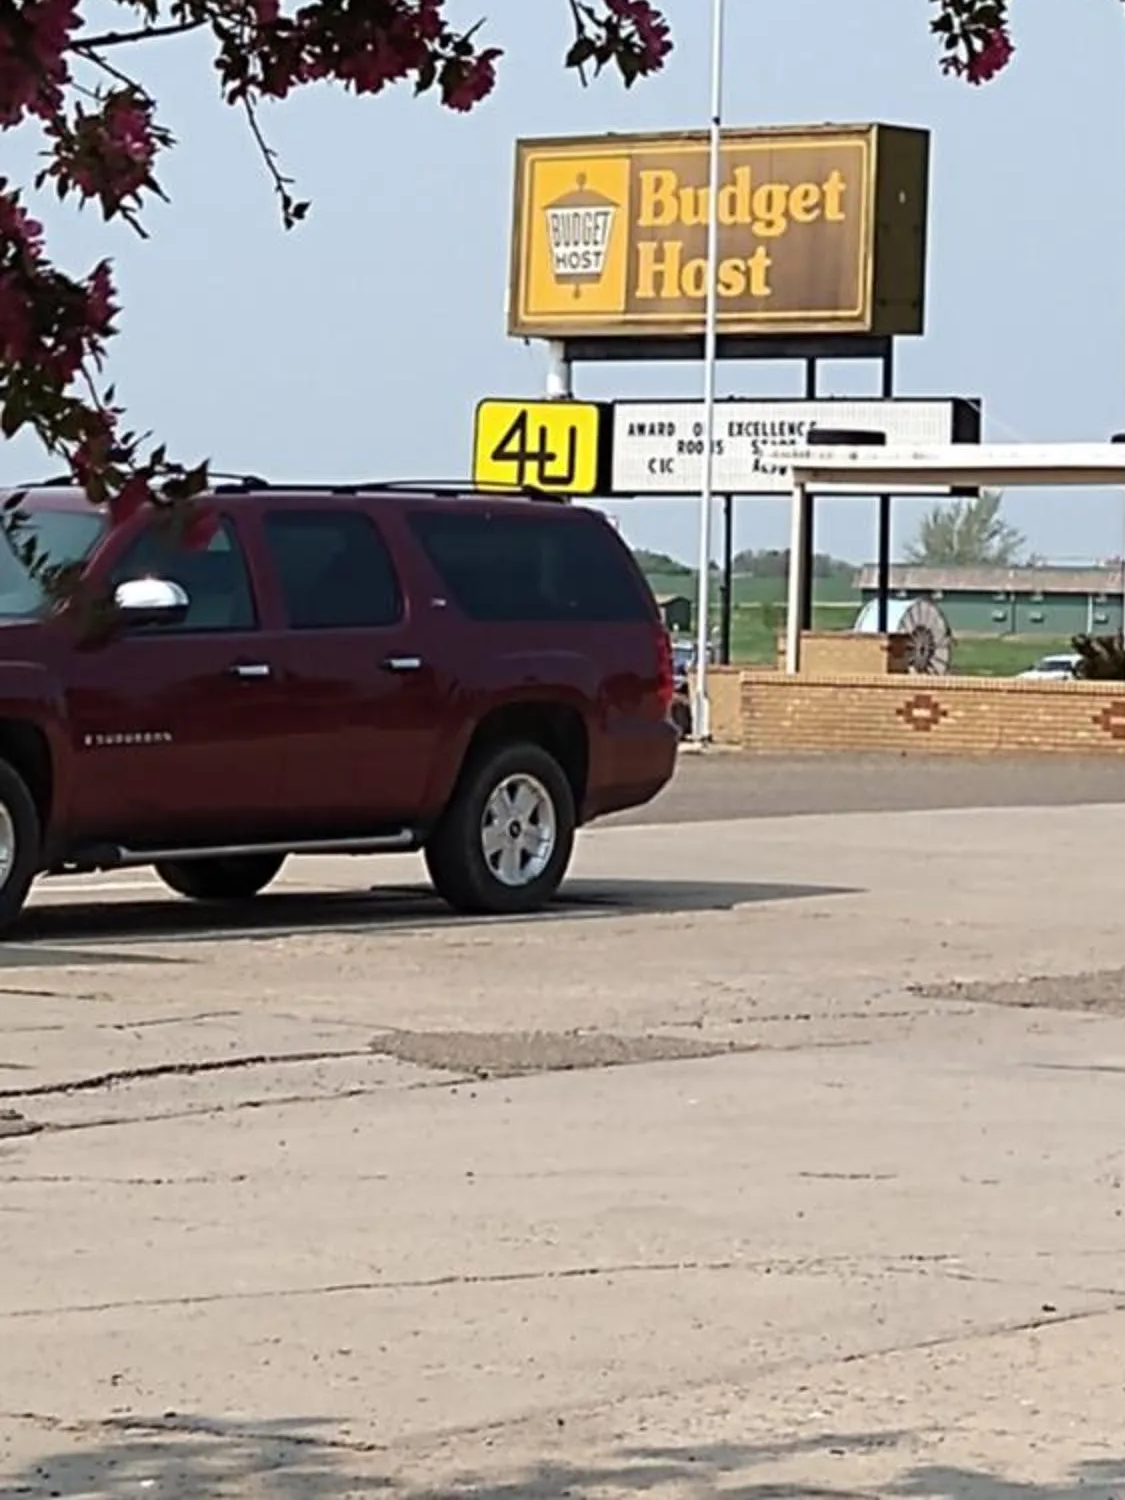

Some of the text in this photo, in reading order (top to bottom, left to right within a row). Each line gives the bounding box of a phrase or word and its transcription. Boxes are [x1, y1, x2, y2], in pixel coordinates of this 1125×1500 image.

[637, 166, 846, 236] Budget
[551, 211, 610, 247] BUDGET
[556, 251, 602, 269] HOST
[636, 241, 771, 299] Host
[628, 422, 675, 437] AWARD
[677, 439, 723, 455] ROOS
